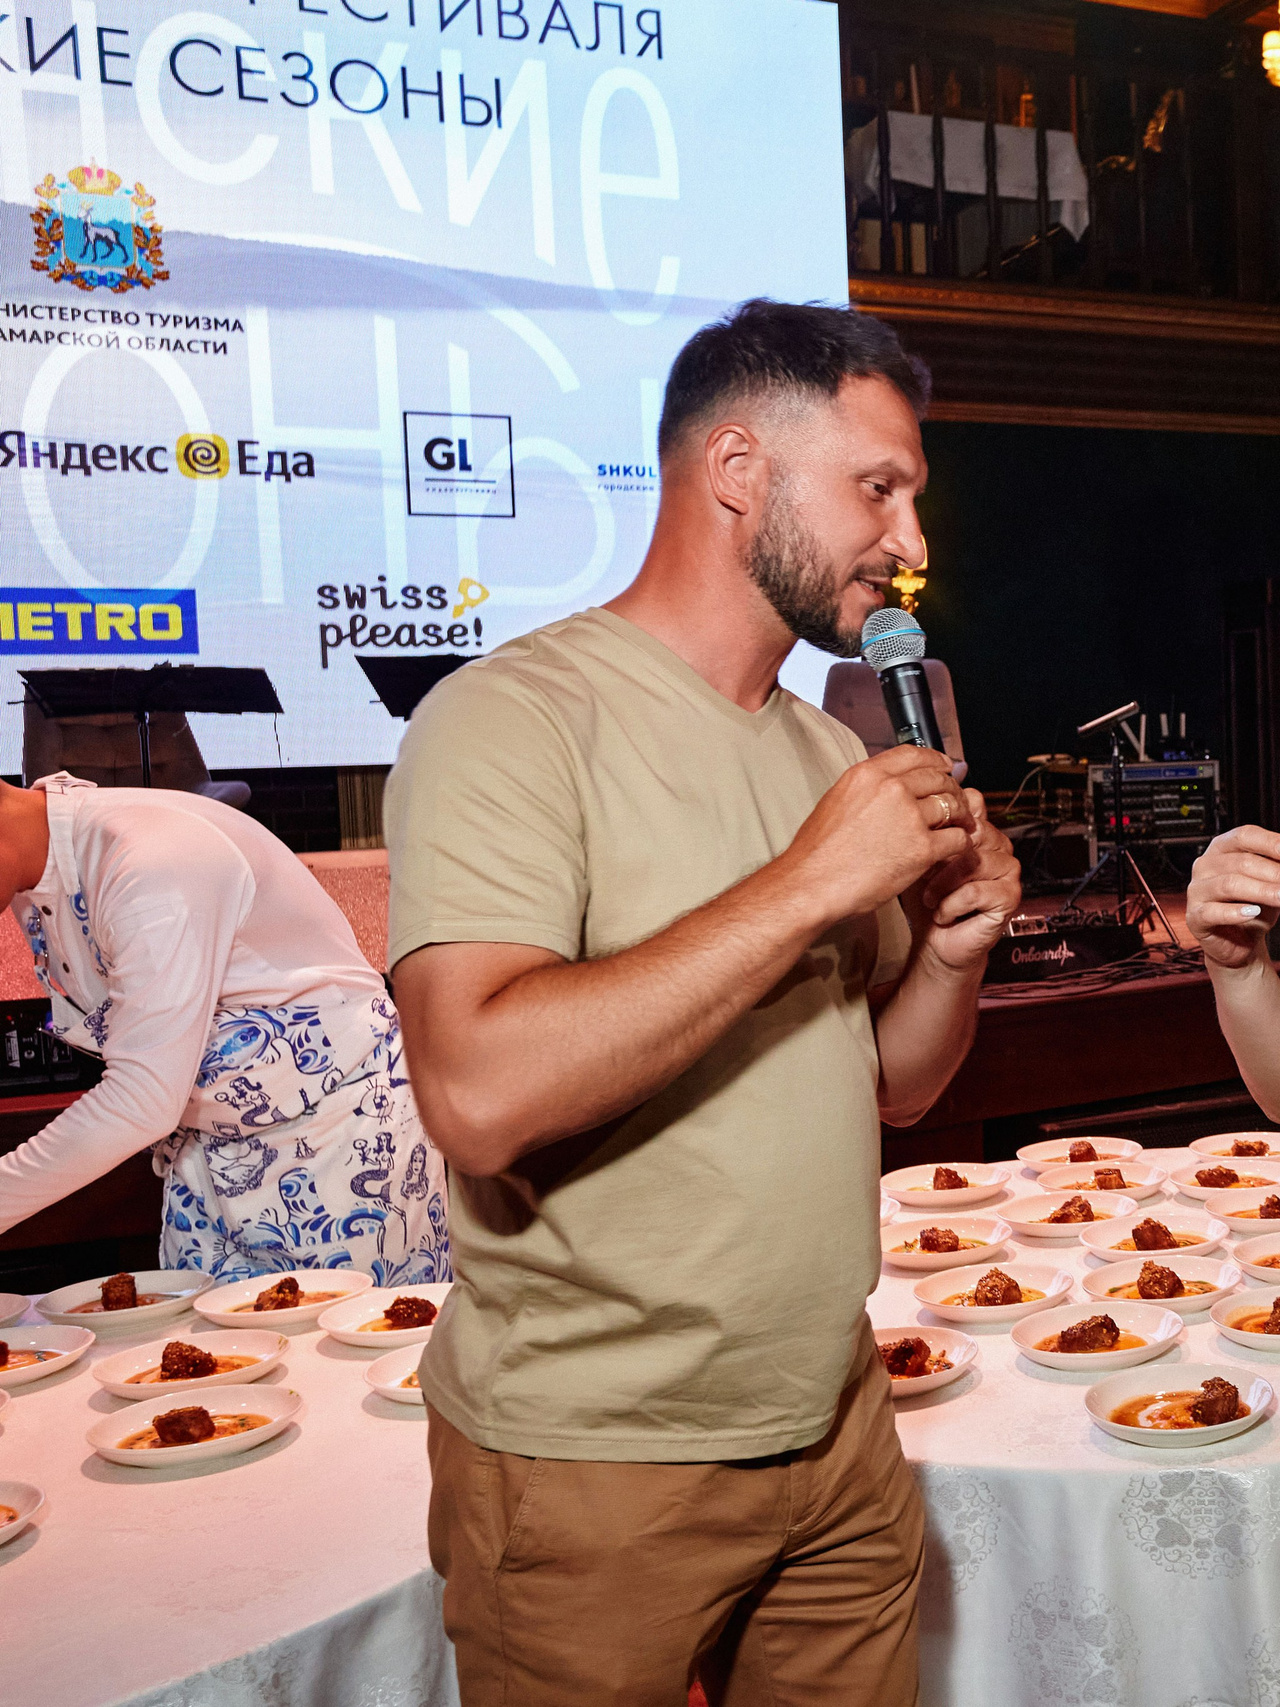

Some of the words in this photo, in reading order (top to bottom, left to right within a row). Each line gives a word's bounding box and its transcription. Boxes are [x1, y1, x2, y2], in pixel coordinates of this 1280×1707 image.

[249, 0, 665, 60] ИВАЛЯ
[168, 38, 502, 129] СЕЗОНЫ
[128, 335, 229, 356] ОБЛАСТИ
[145, 312, 245, 333] ТУРИЗМА
[0, 430, 169, 477] Яндекс
[237, 439, 316, 483] Еда
[316, 574, 449, 610] swiss
[319, 613, 483, 670] please!
